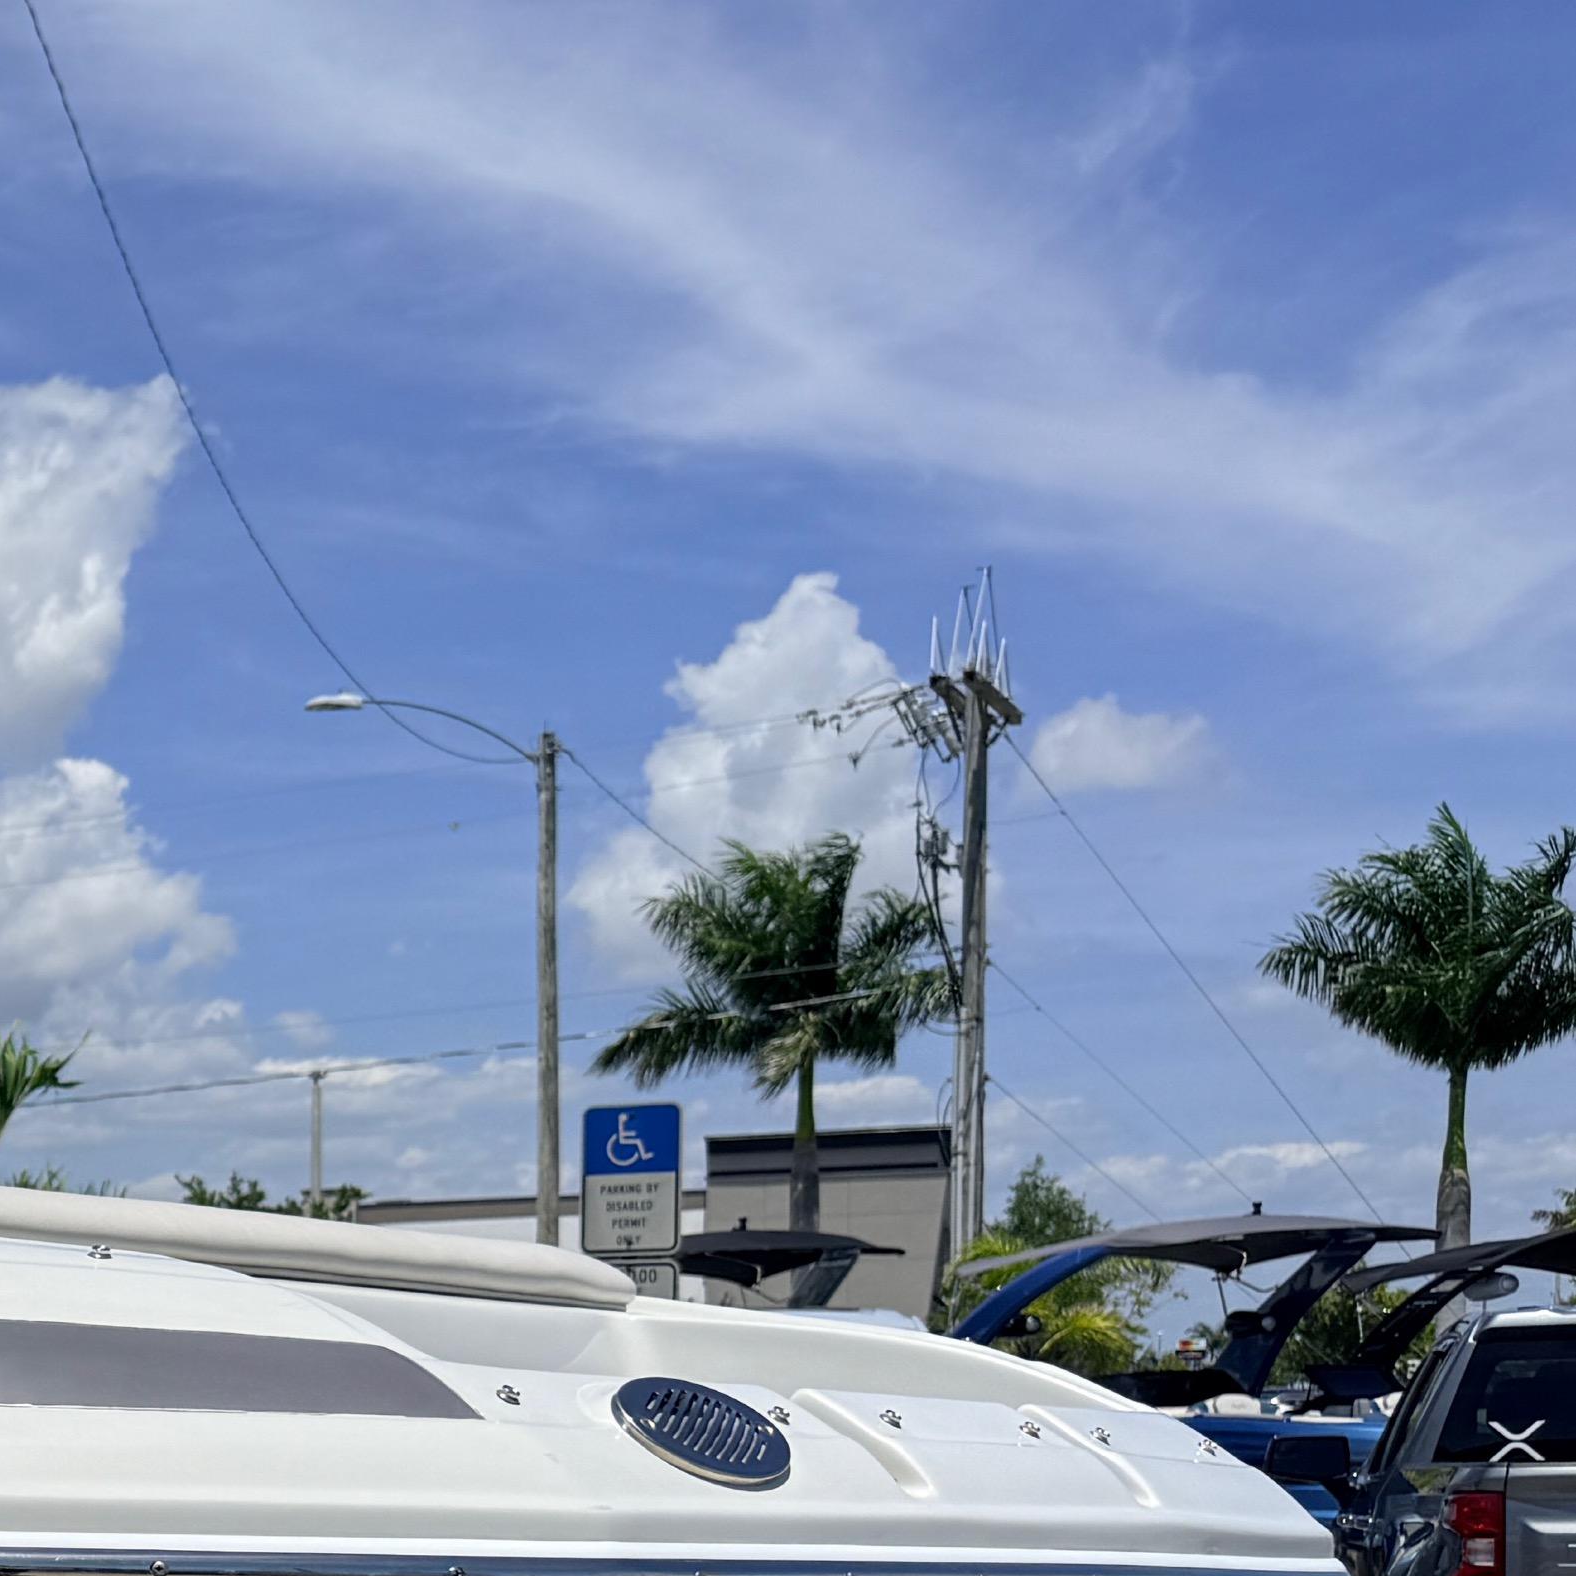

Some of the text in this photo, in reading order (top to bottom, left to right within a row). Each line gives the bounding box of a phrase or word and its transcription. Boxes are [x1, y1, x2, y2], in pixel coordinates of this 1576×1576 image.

[600, 1183, 659, 1195] PARKING BY
[607, 1201, 653, 1212] DISABLED
[612, 1218, 645, 1229] PERMIT
[616, 1236, 641, 1246] ONLY
